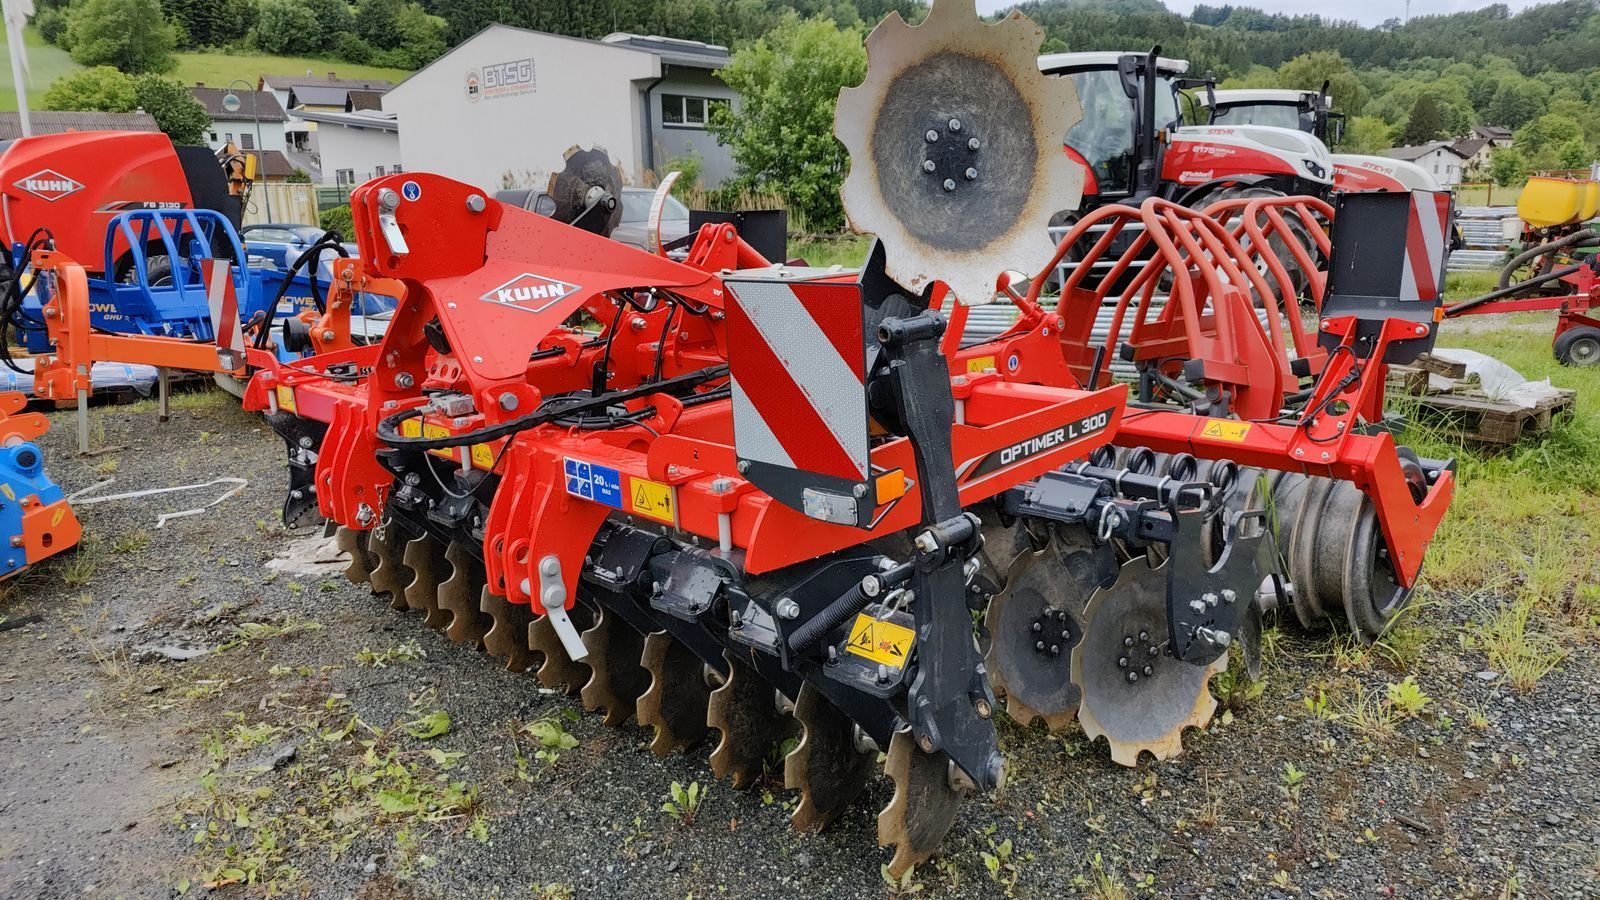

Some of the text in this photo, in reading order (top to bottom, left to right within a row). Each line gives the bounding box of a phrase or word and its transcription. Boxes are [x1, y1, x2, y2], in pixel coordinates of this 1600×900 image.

[483, 59, 531, 89] BTSG
[1362, 161, 1393, 174] STEYR
[26, 179, 73, 191] KUHN
[497, 283, 565, 303] KUHN
[1000, 412, 1107, 465] OPTIMER L 300
[594, 474, 604, 485] 20
